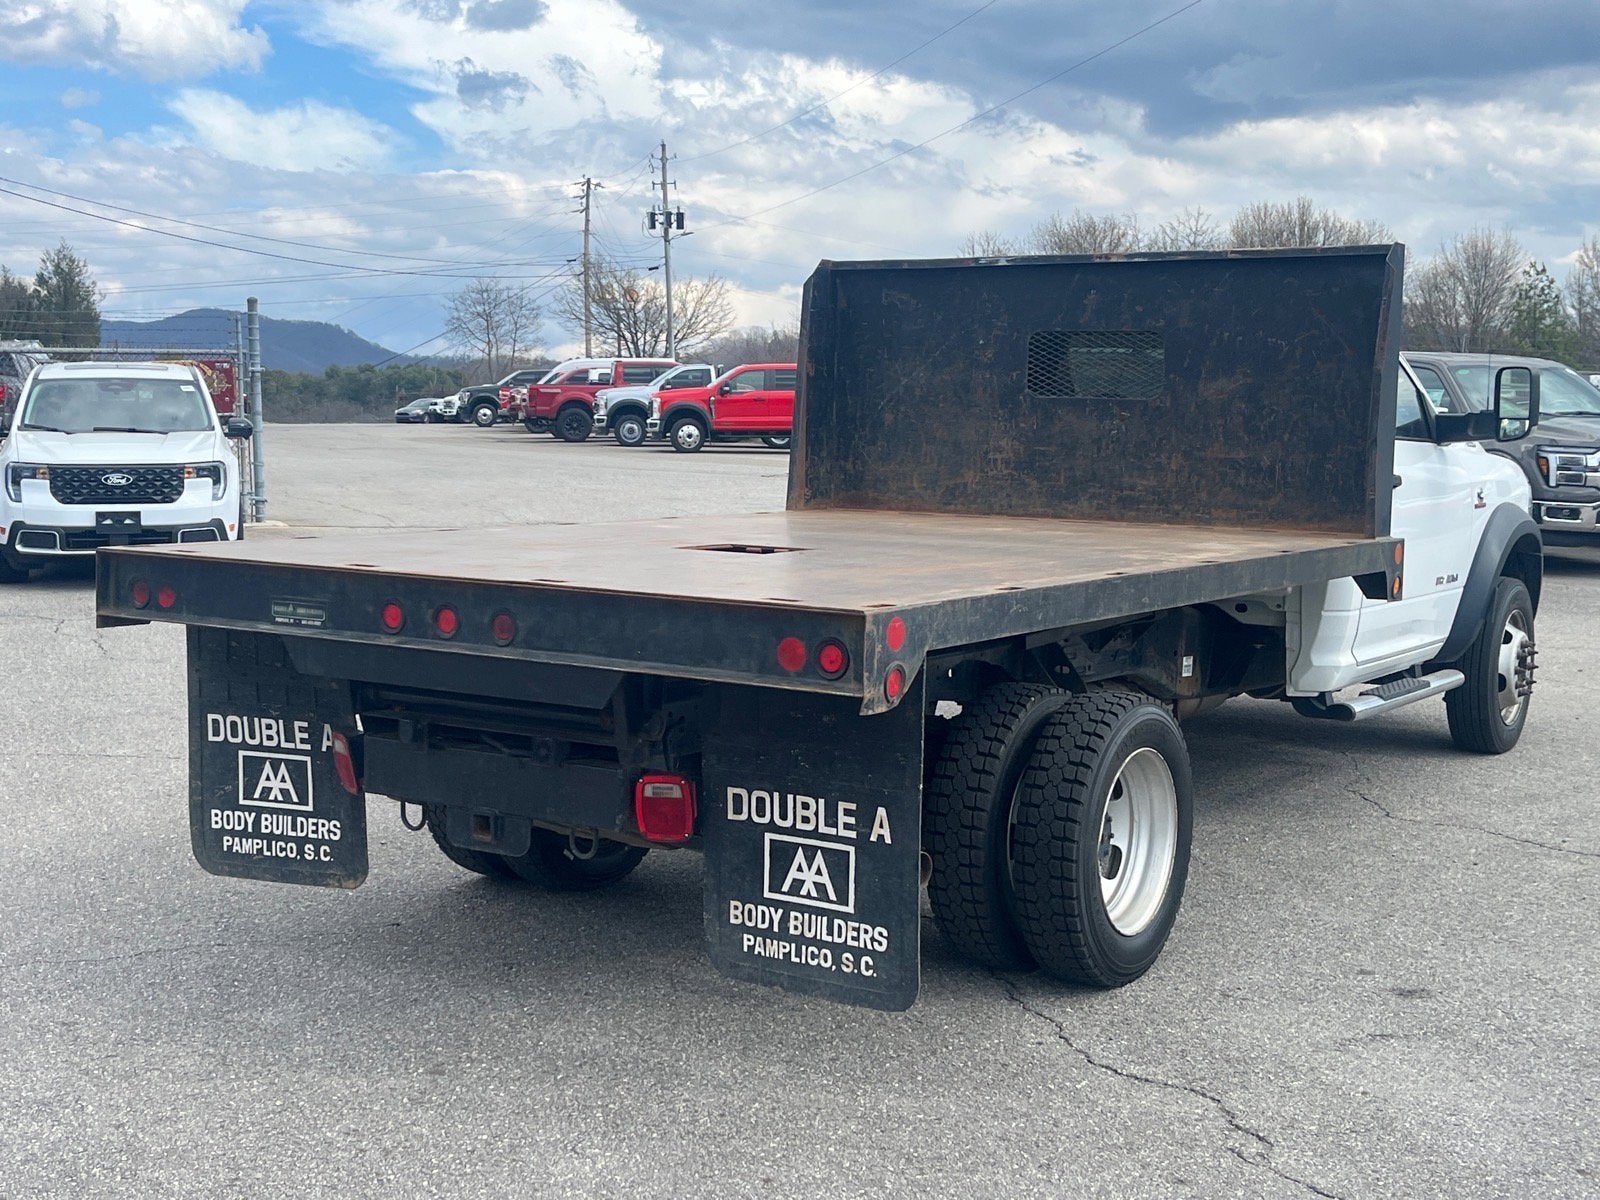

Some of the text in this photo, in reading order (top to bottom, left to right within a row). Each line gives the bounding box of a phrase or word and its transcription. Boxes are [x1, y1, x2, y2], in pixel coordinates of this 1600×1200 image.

[105, 474, 129, 485] Ford
[207, 713, 333, 752] DOUBLE A
[210, 809, 341, 841] BODY BUILDERS
[726, 786, 892, 844] DOUBLE A
[222, 836, 300, 860] PAMPLICO,
[729, 900, 889, 953] BODY BUILDERS
[742, 933, 836, 972] PAMPLICO,
